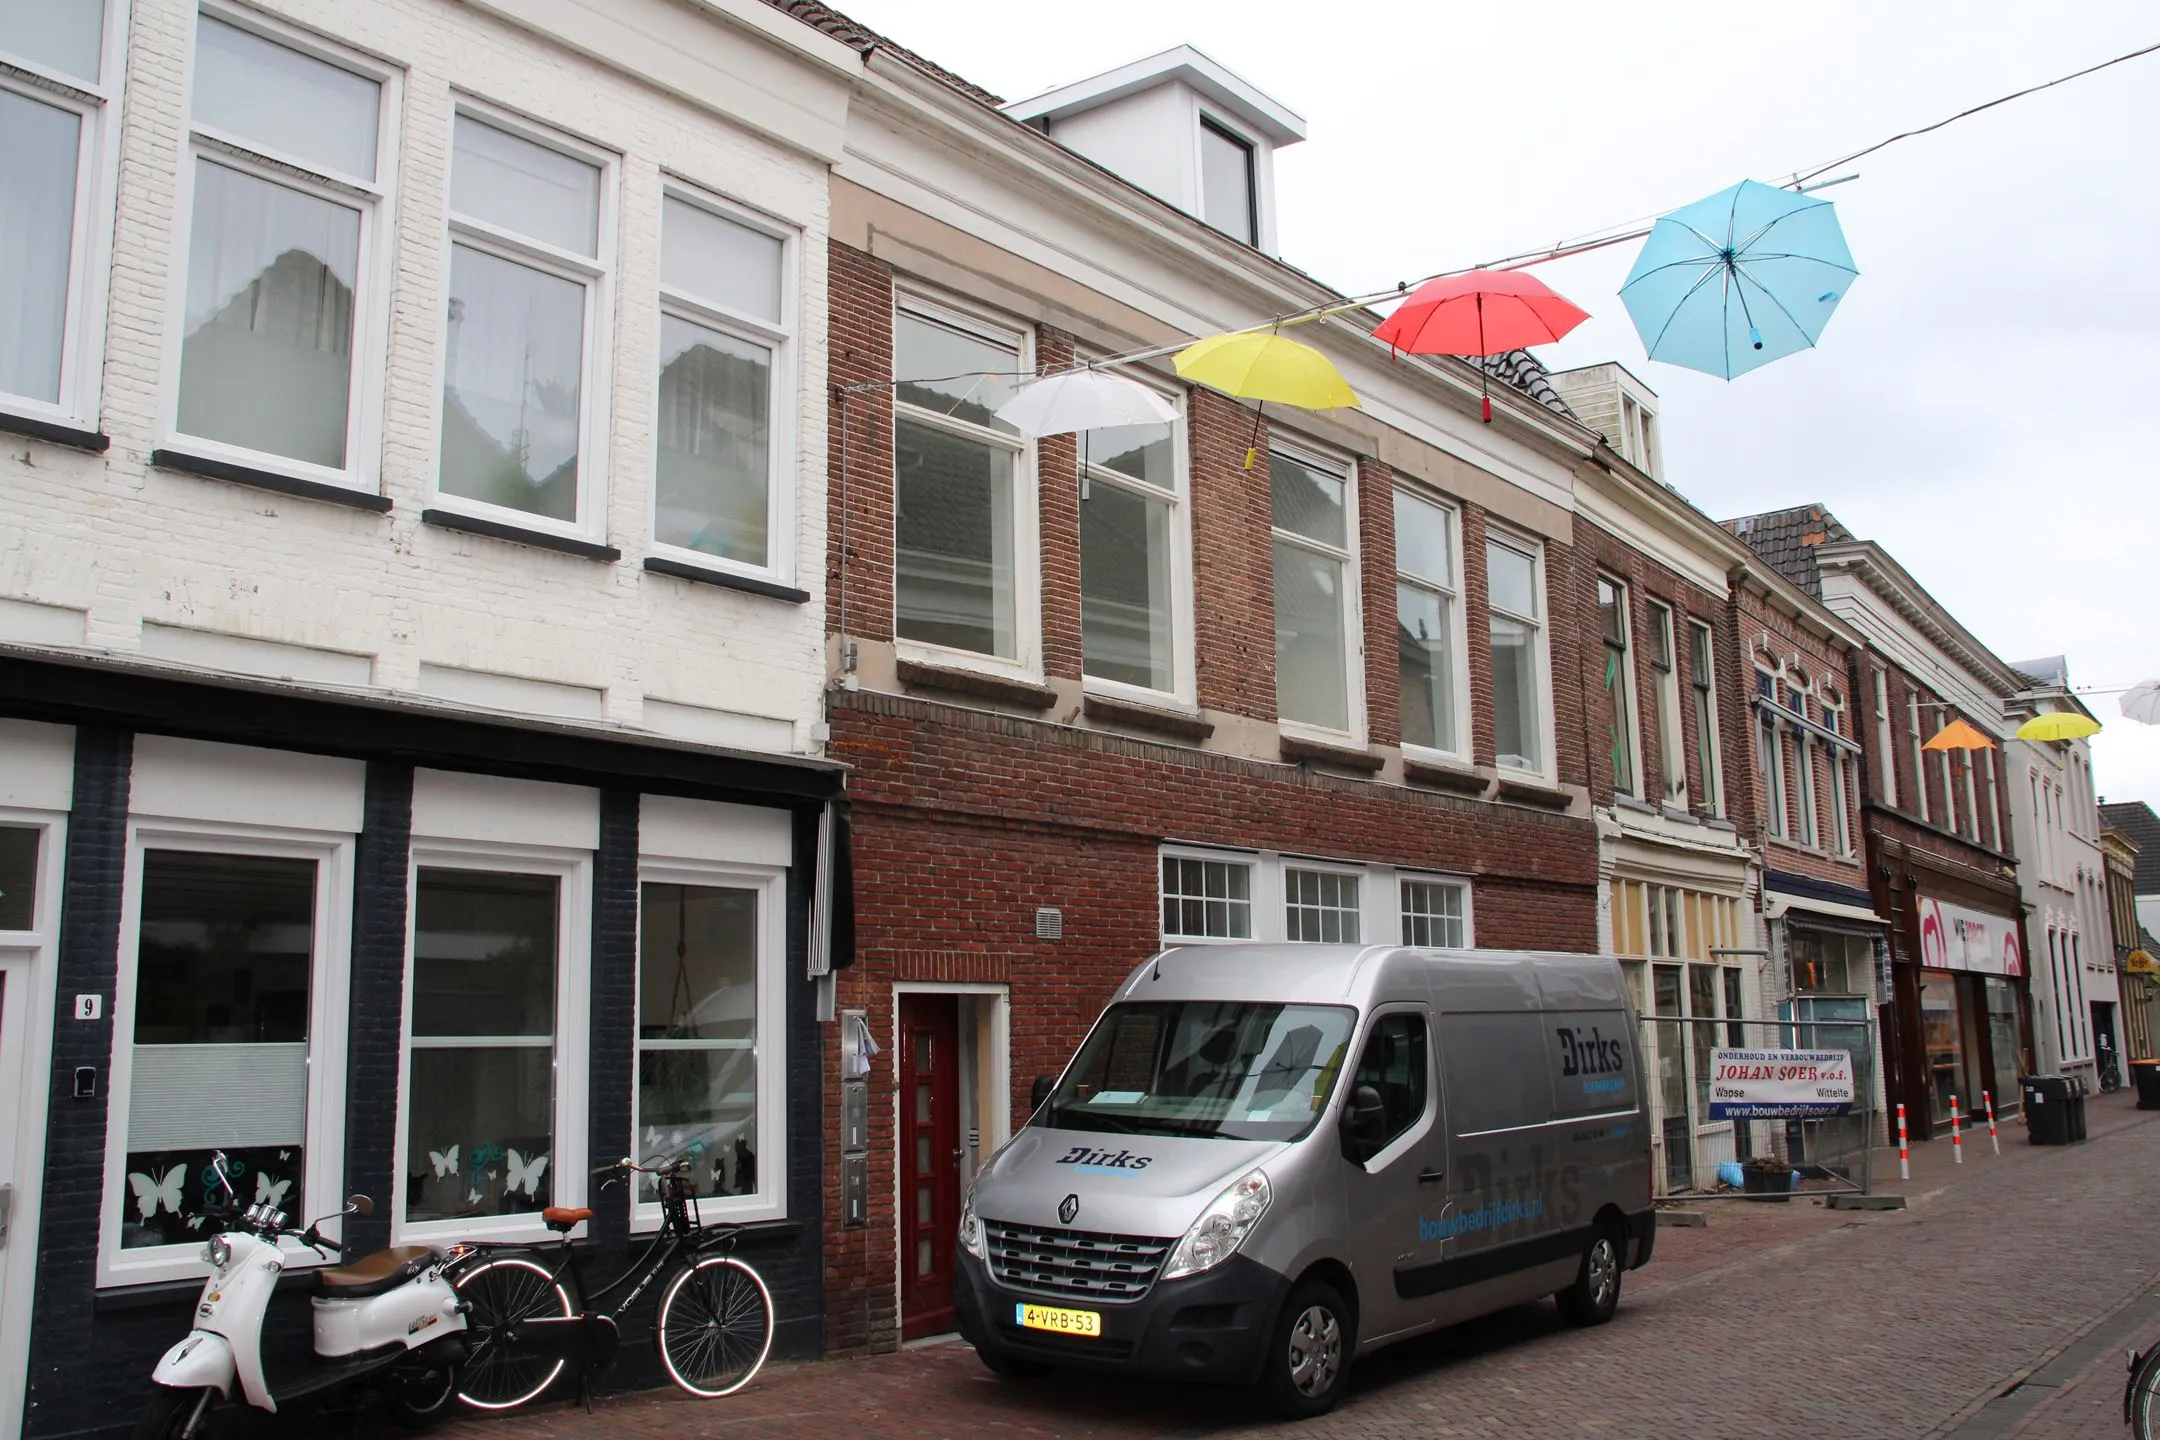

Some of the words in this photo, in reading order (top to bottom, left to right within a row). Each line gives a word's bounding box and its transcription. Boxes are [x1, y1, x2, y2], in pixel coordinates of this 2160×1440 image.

[84, 998, 94, 1017] 9
[1556, 1026, 1623, 1076] Dirks
[1717, 1051, 1766, 1061] ONDERHOUD
[1768, 1053, 1778, 1061] EN
[1780, 1053, 1845, 1062] VERBOUWBEDRIJF
[1716, 1064, 1774, 1081] JOHAN
[1778, 1065, 1817, 1081] SOER
[1820, 1070, 1847, 1081] v.o.f.
[1715, 1086, 1745, 1098] Wapse
[1816, 1087, 1849, 1098] Wittelte
[1725, 1104, 1839, 1118] www.bouwbedrijfsoer.nl
[1055, 1147, 1153, 1170] Dirks
[1418, 1193, 1544, 1242] bouwbedrijfdirks.nl
[1027, 1308, 1094, 1332] 4-VRB-53
